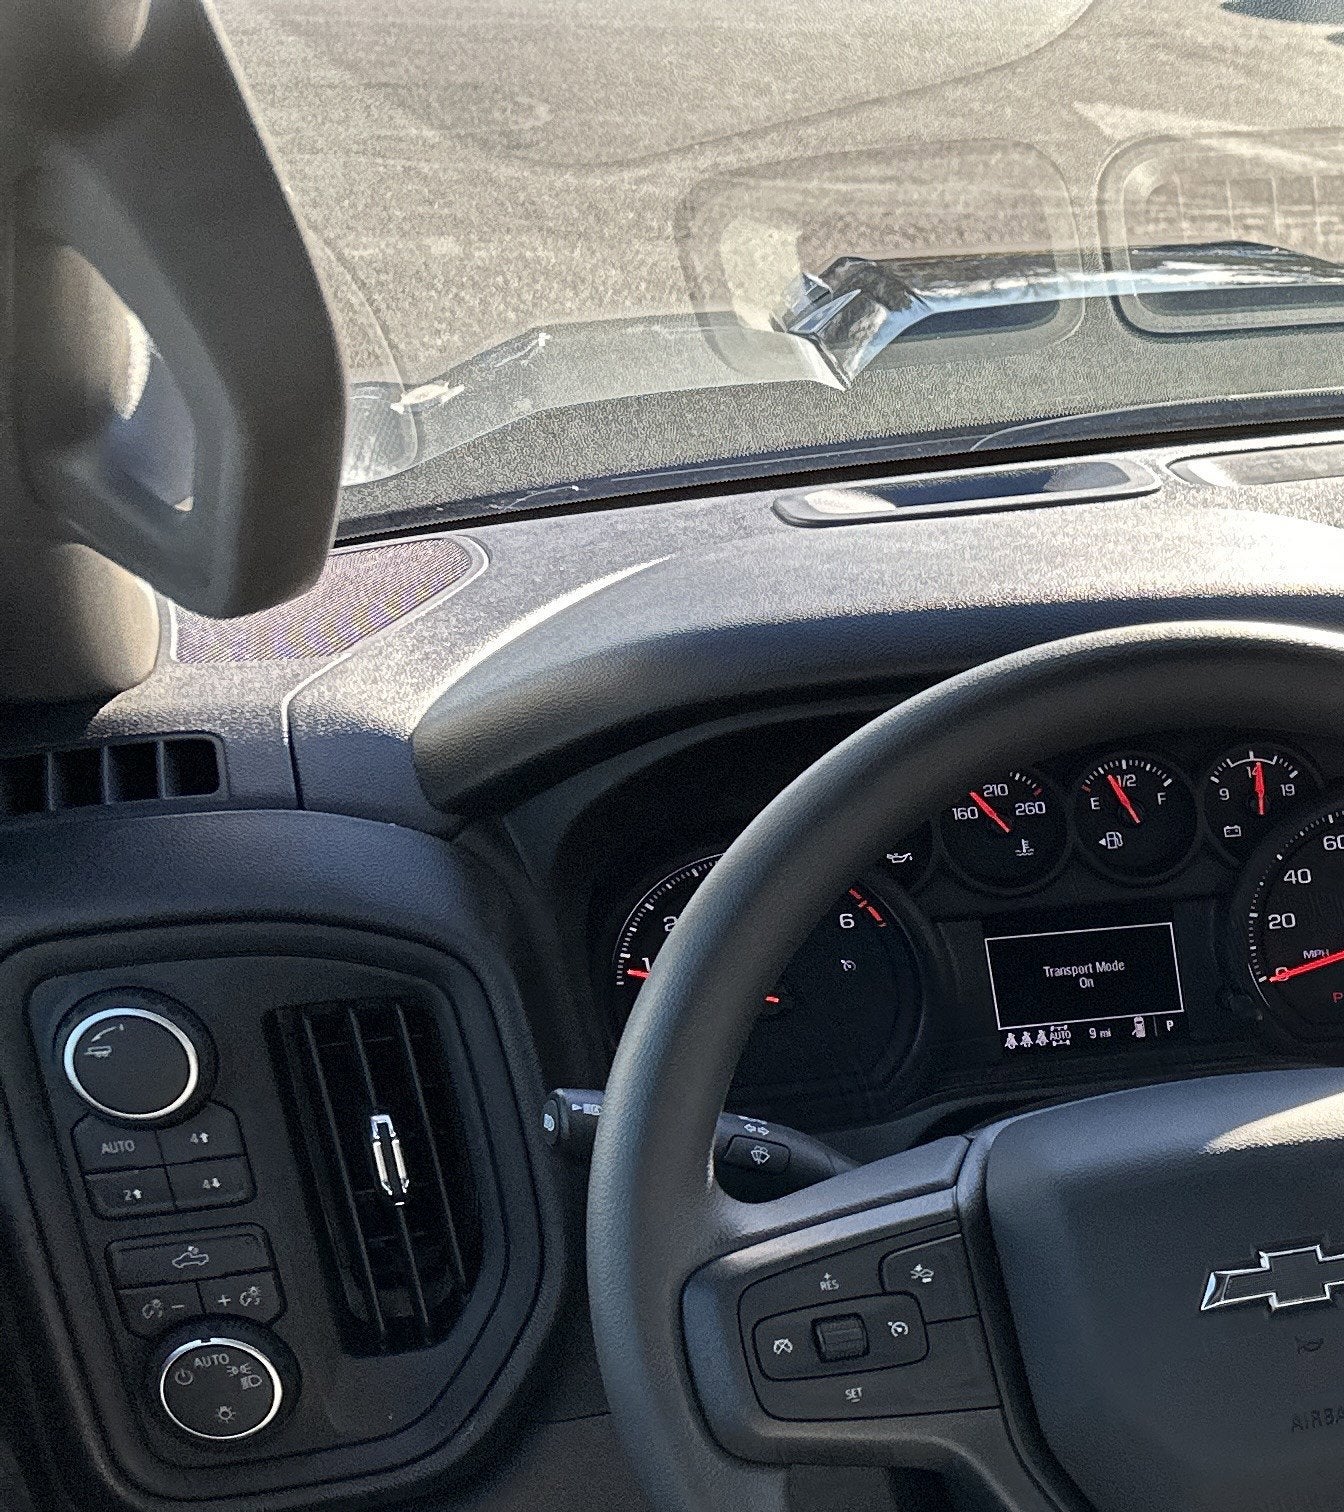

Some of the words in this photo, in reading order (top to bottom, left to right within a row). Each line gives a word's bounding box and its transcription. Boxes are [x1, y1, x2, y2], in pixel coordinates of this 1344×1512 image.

[982, 784, 1008, 797] 210
[1219, 788, 1230, 800] 9
[1280, 784, 1295, 796] 19
[1091, 798, 1100, 810] E
[1157, 792, 1167, 805] F
[952, 806, 978, 821] 160
[1015, 802, 1046, 816] 260
[1283, 869, 1311, 884] 40
[840, 913, 854, 928] 6
[1268, 913, 1296, 929] 20
[1303, 949, 1329, 959] MPH
[1043, 963, 1093, 978] Transport
[1096, 960, 1125, 973] Mode
[1079, 977, 1094, 988] On
[1332, 992, 1343, 1002] P
[1166, 1020, 1173, 1031] P
[1050, 1030, 1071, 1040] AUTO
[1089, 1028, 1096, 1039] 9
[1100, 1028, 1111, 1038] mi
[102, 1140, 135, 1154] AUTO
[820, 1279, 840, 1291] RES
[194, 1354, 229, 1368] AUTO
[845, 1387, 862, 1400] SET
